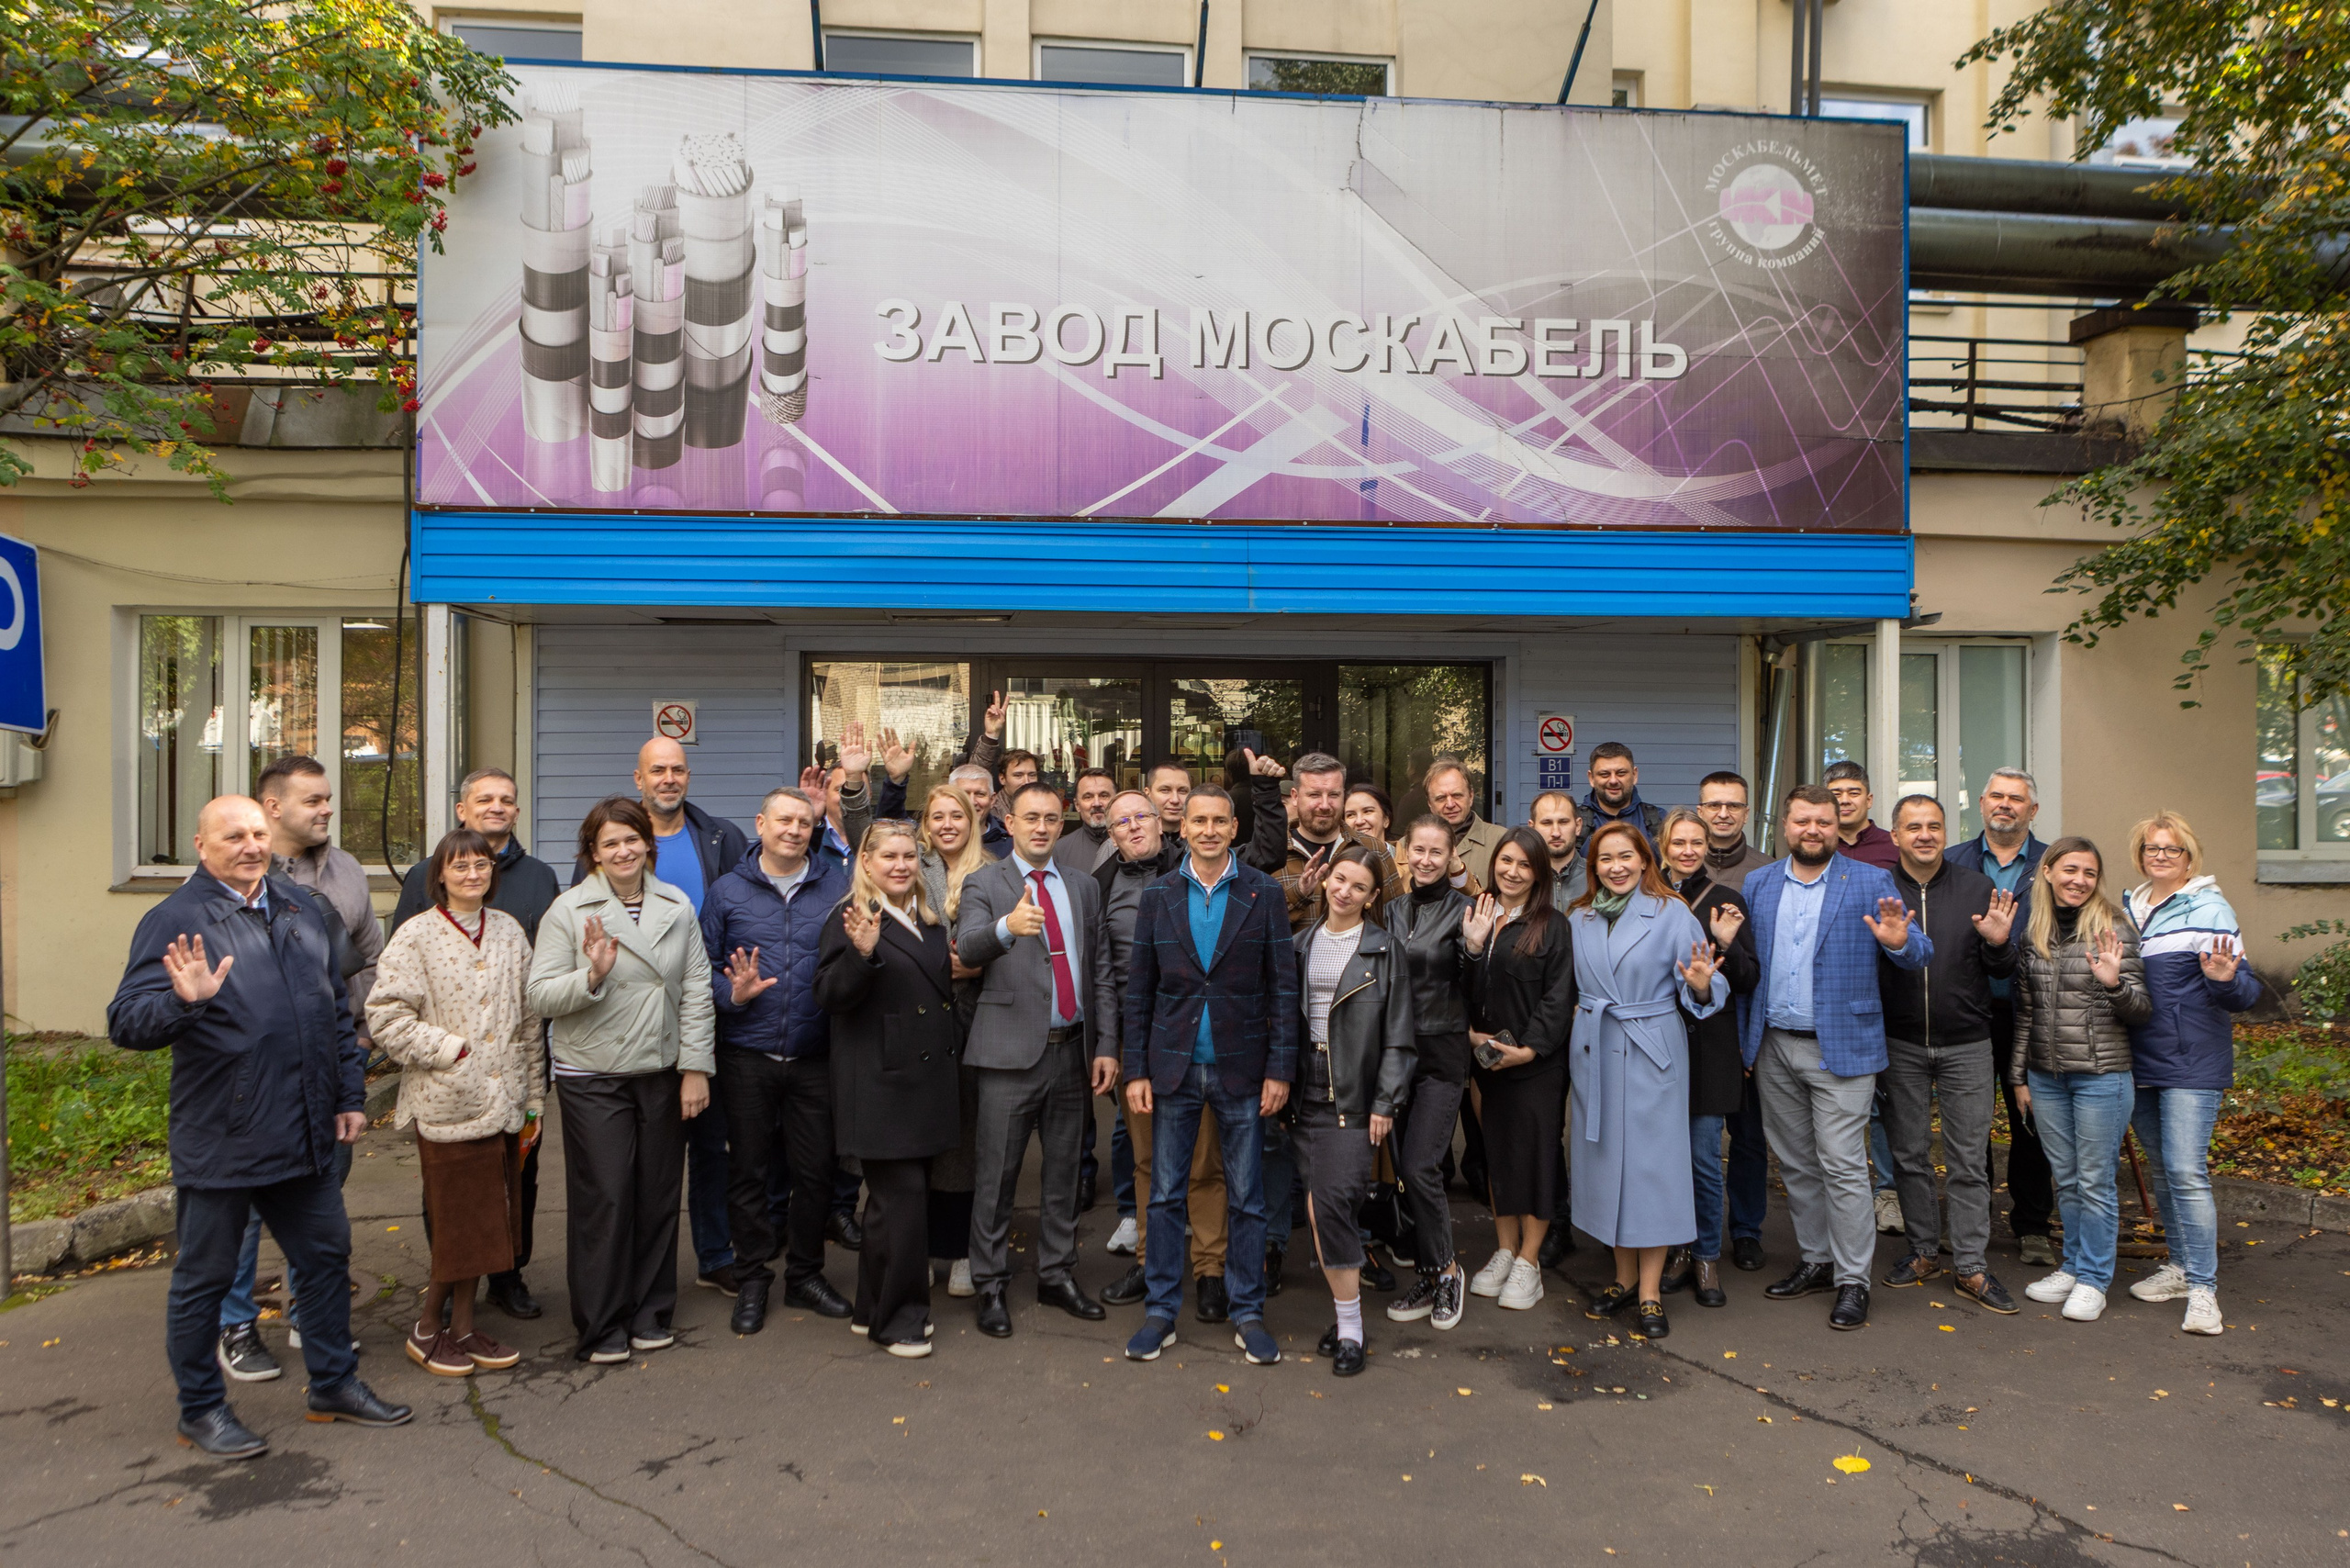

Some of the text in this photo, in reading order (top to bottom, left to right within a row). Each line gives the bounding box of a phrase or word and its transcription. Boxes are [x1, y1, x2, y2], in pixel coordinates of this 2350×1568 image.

[1705, 140, 1829, 196] МОСКАБЕЛЬМЕТ
[1709, 221, 1826, 269] группа компаний
[873, 297, 1691, 381] ЗАВОД МОСКАБЕЛЬ
